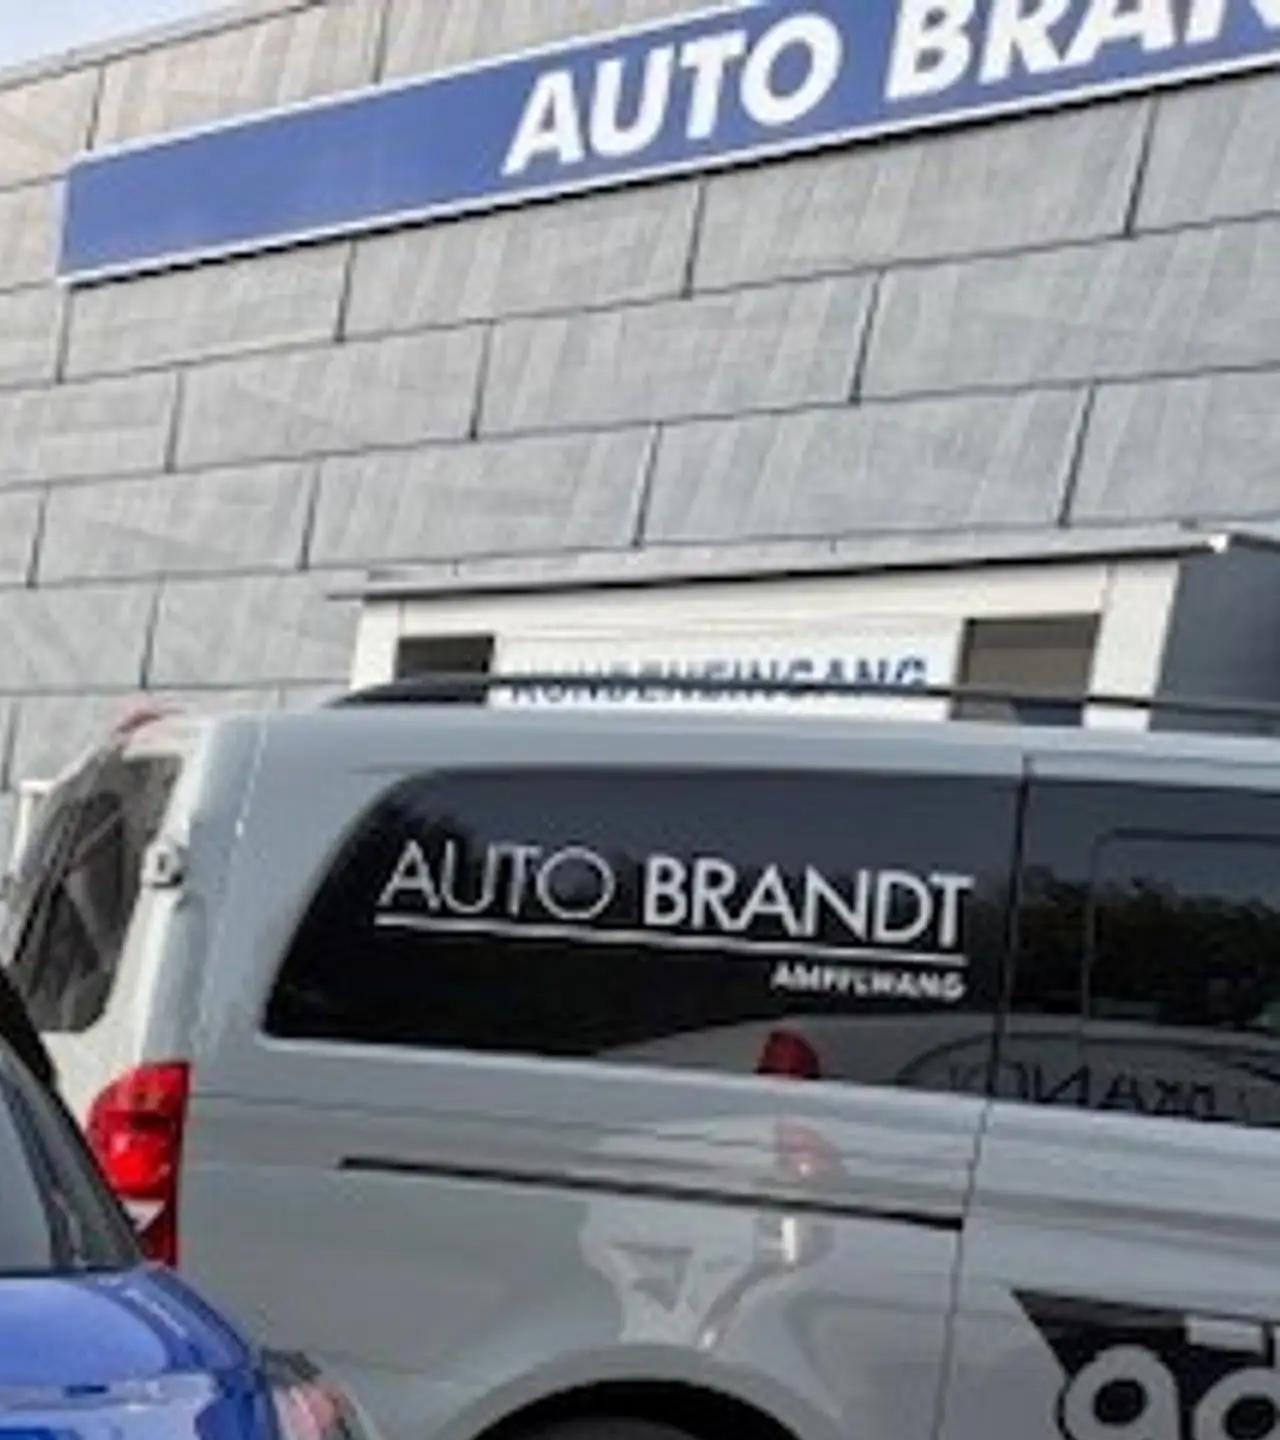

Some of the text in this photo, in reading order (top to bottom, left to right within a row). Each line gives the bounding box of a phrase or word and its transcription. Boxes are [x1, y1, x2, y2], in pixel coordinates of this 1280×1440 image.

[501, 14, 842, 177] AUTO
[379, 839, 975, 948] AUTO BRANDT
